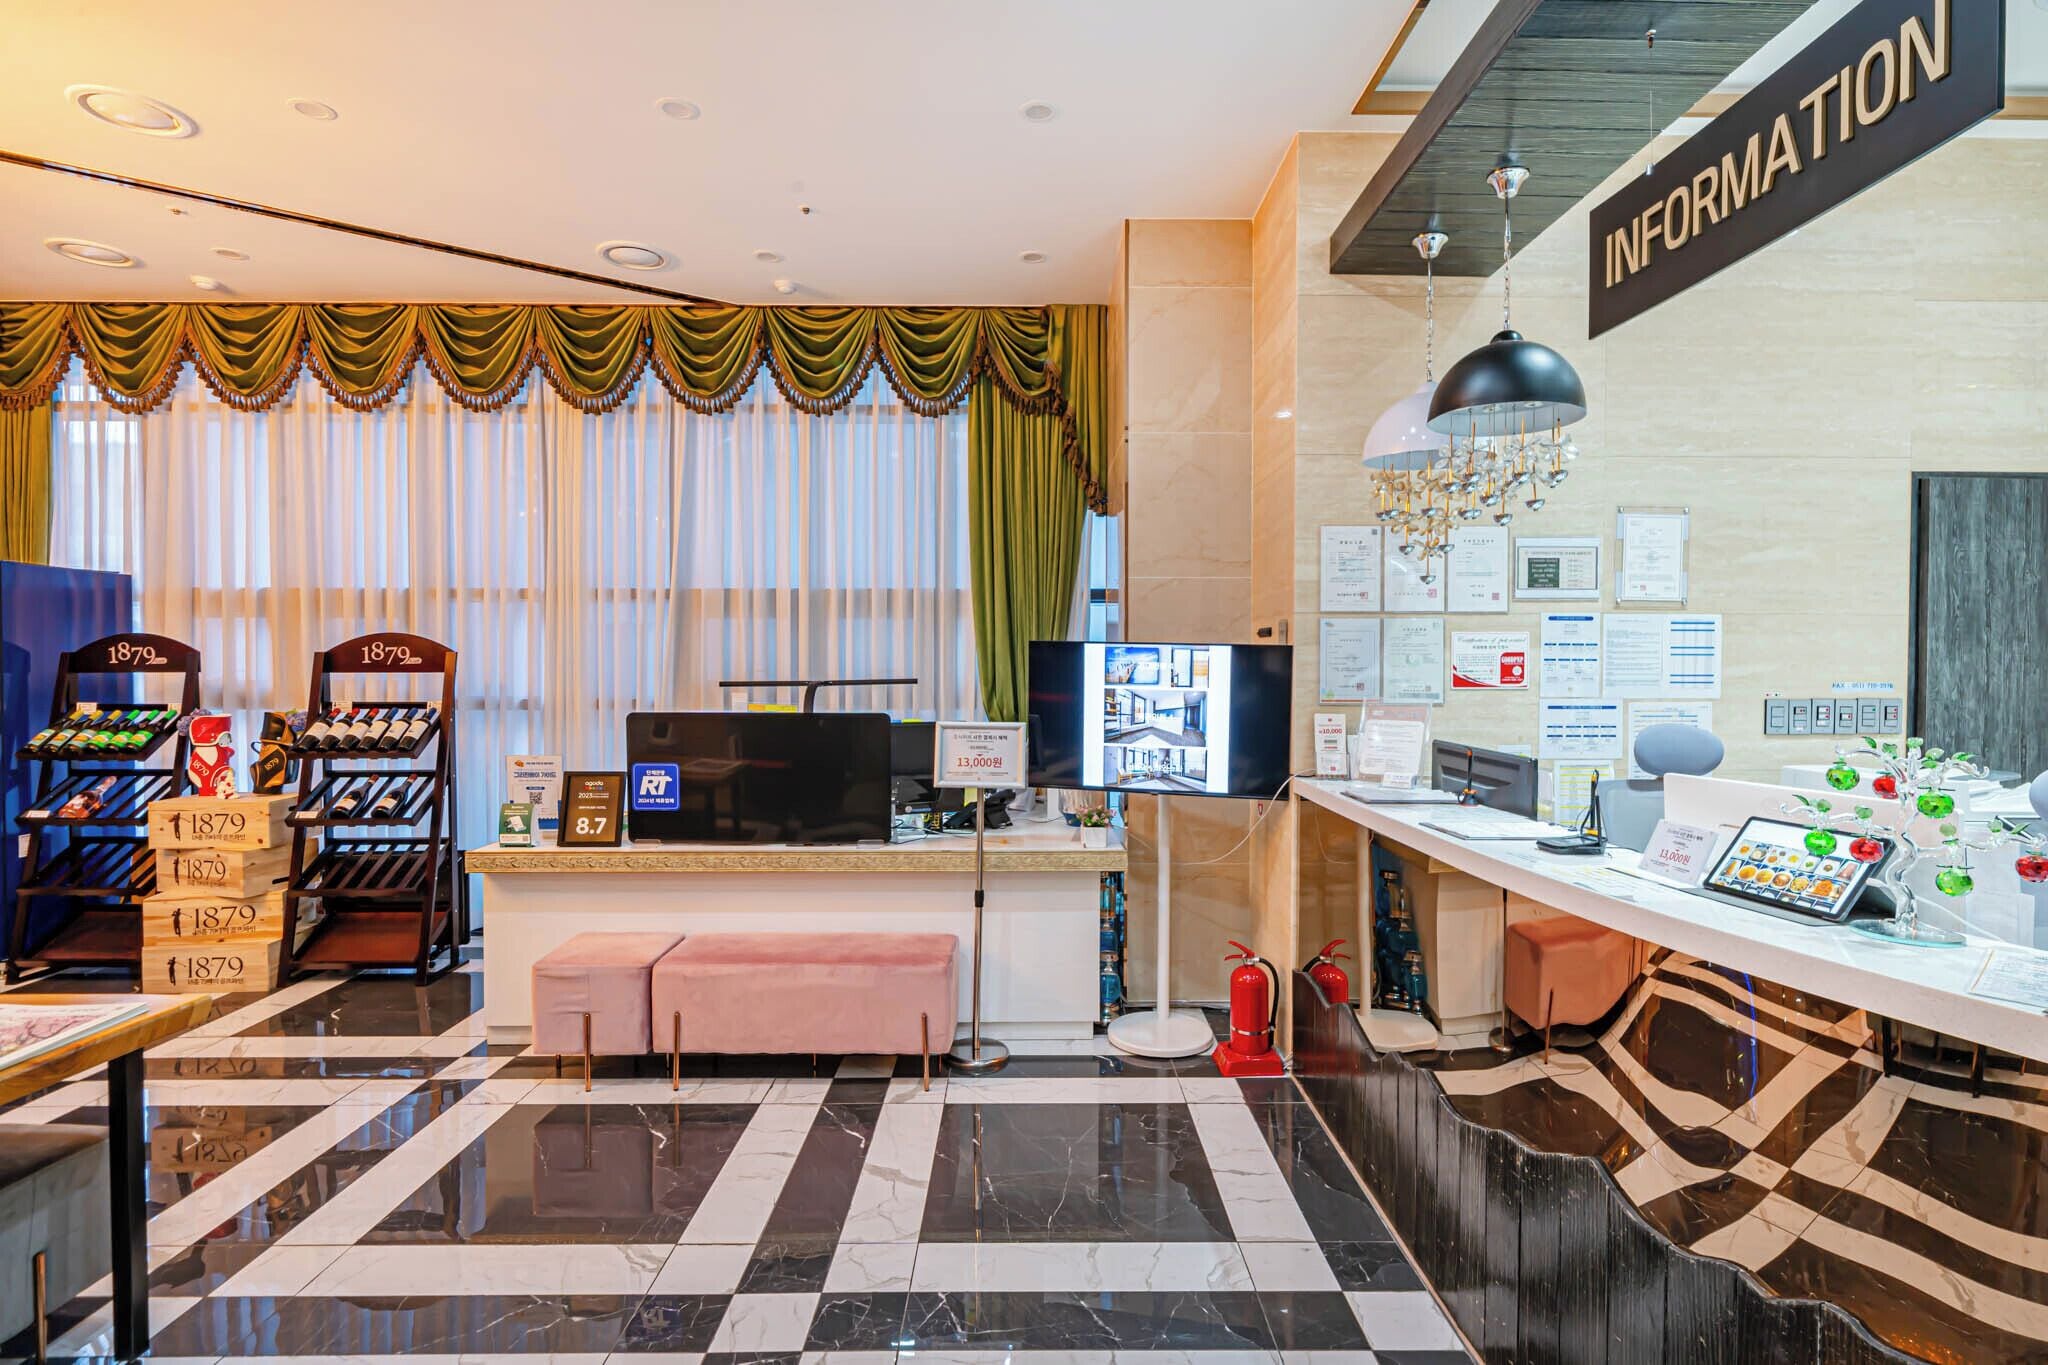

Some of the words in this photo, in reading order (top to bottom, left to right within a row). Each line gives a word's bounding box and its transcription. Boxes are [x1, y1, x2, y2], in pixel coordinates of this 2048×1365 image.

[1605, 0, 1952, 289] INFORMATION
[108, 642, 156, 665] 1879
[361, 642, 410, 665] 1879
[192, 760, 209, 776] 1879
[264, 757, 279, 770] 1879
[957, 757, 1002, 768] 13,000원
[640, 776, 672, 795] RT
[192, 813, 246, 834] 1879
[576, 817, 607, 834] 8.7
[1659, 849, 1691, 866] 13,000원
[186, 859, 226, 880] 1879
[195, 904, 256, 929] 1879
[187, 956, 244, 978] 1879
